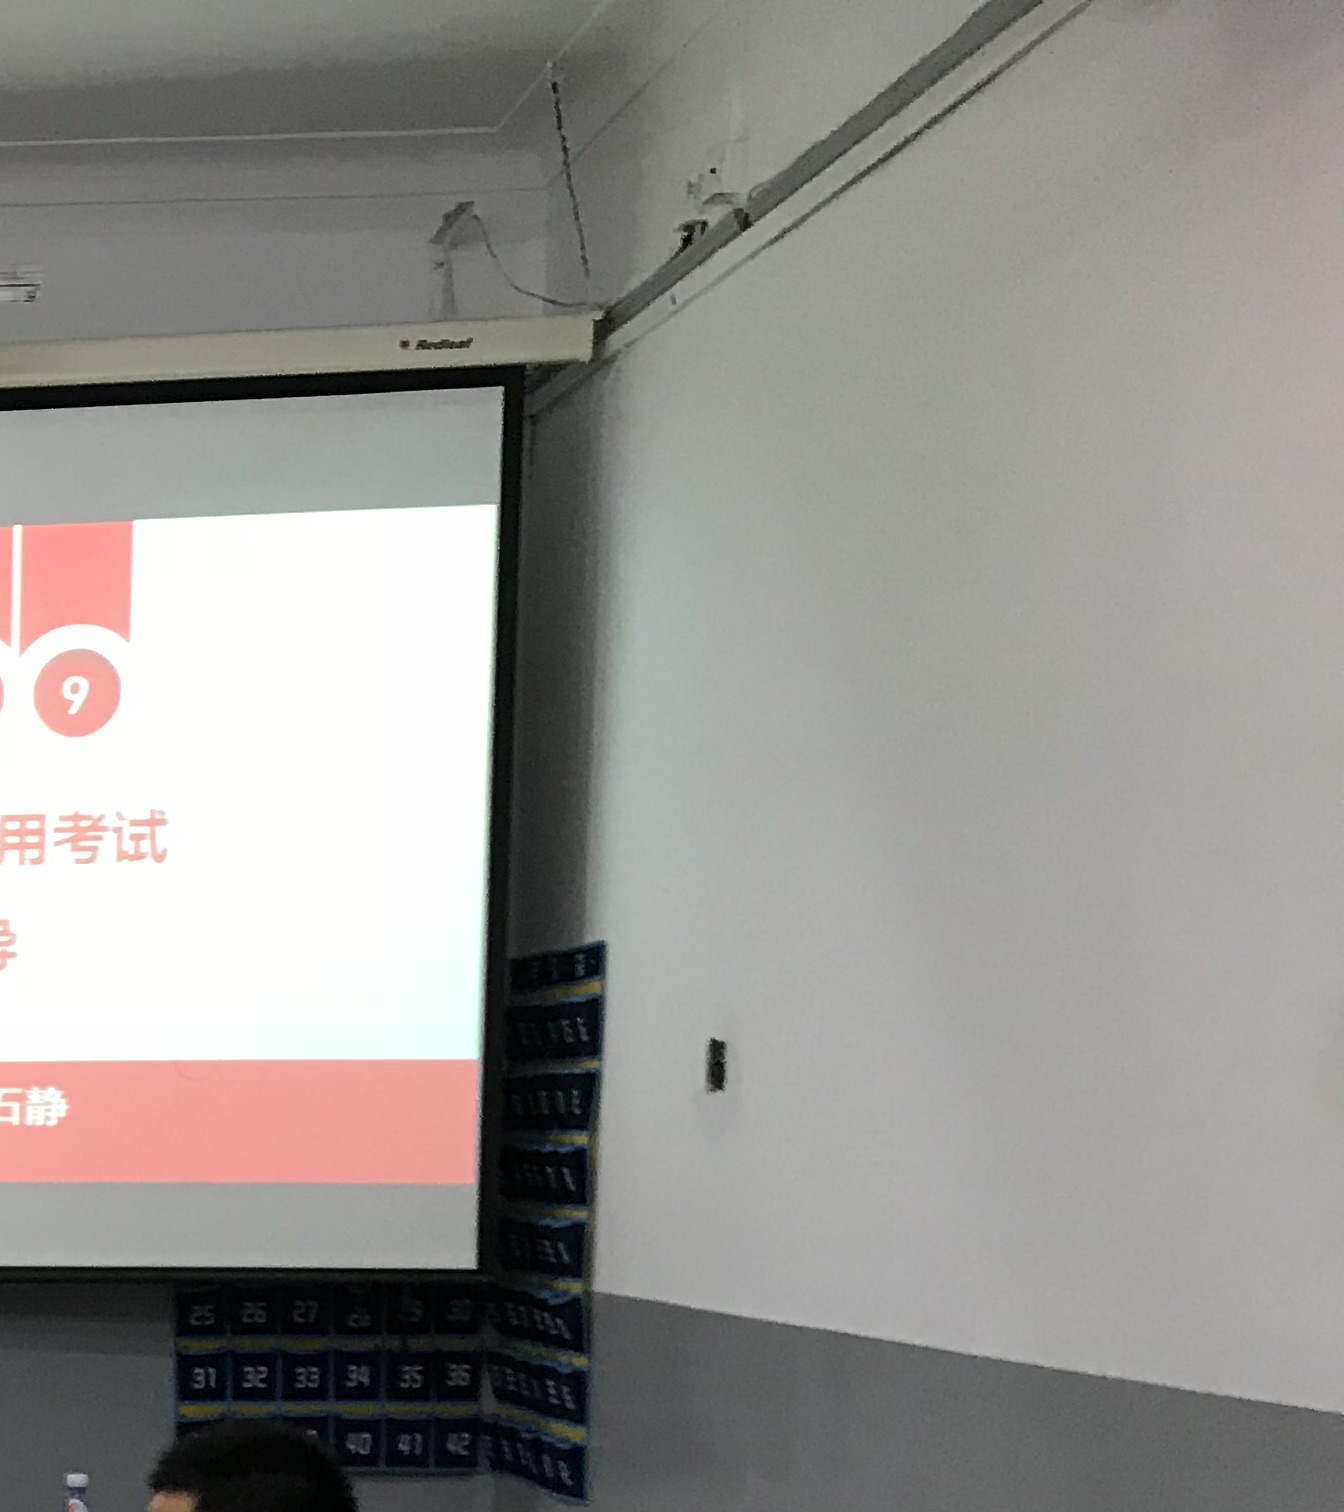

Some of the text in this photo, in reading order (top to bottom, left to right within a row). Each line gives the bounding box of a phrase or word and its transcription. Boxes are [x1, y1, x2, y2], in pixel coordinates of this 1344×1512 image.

[191, 1366, 217, 1389] 31
[242, 1365, 268, 1389] 32
[294, 1366, 320, 1389] 33
[345, 1364, 371, 1388] 34
[399, 1364, 424, 1388] 35
[446, 1363, 472, 1387] 36
